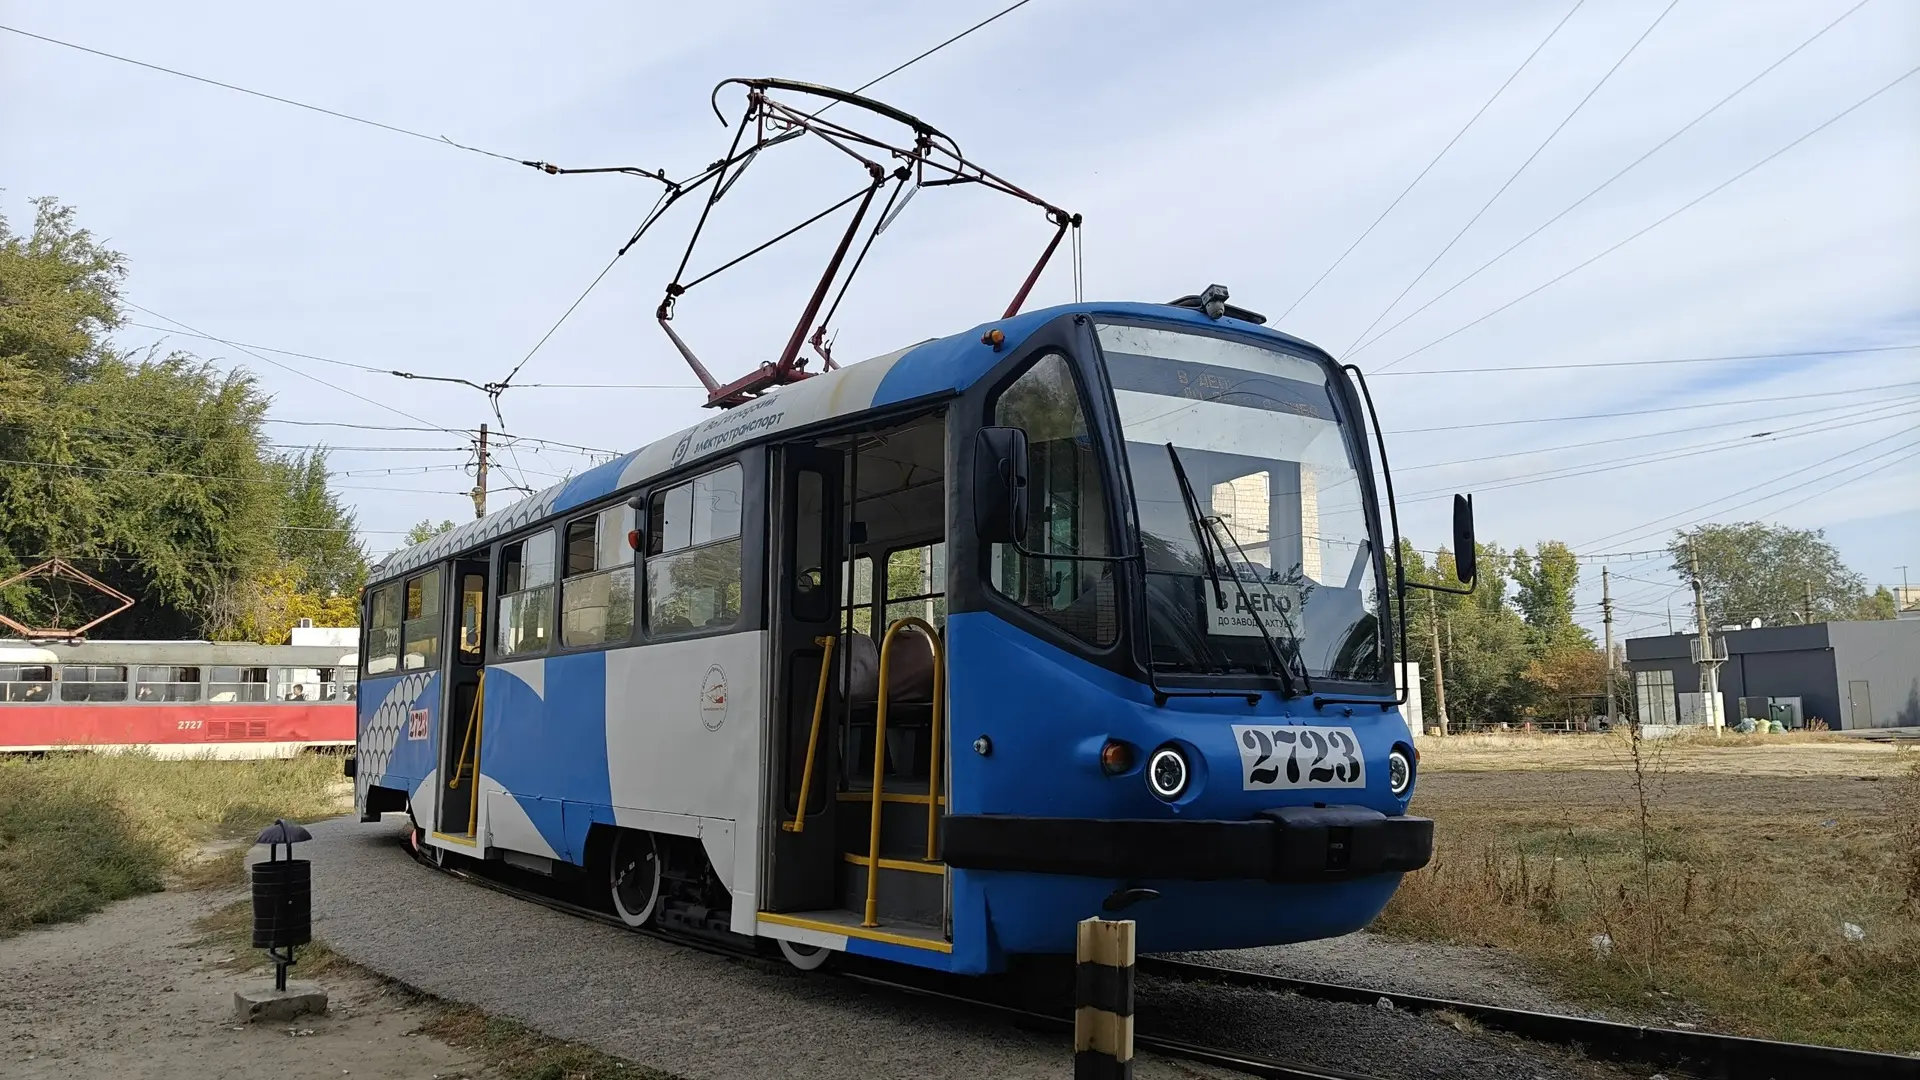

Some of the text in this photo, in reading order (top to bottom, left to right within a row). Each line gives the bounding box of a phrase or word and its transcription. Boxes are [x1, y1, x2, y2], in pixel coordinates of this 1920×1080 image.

[694, 411, 785, 454] электротранспорт
[1235, 592, 1292, 614] ДЕПО
[1218, 617, 1230, 627] ДО
[1231, 617, 1262, 628] ЗАВОД
[177, 720, 204, 730] 2727
[410, 712, 427, 738] 2723
[1242, 729, 1361, 784] 2723
